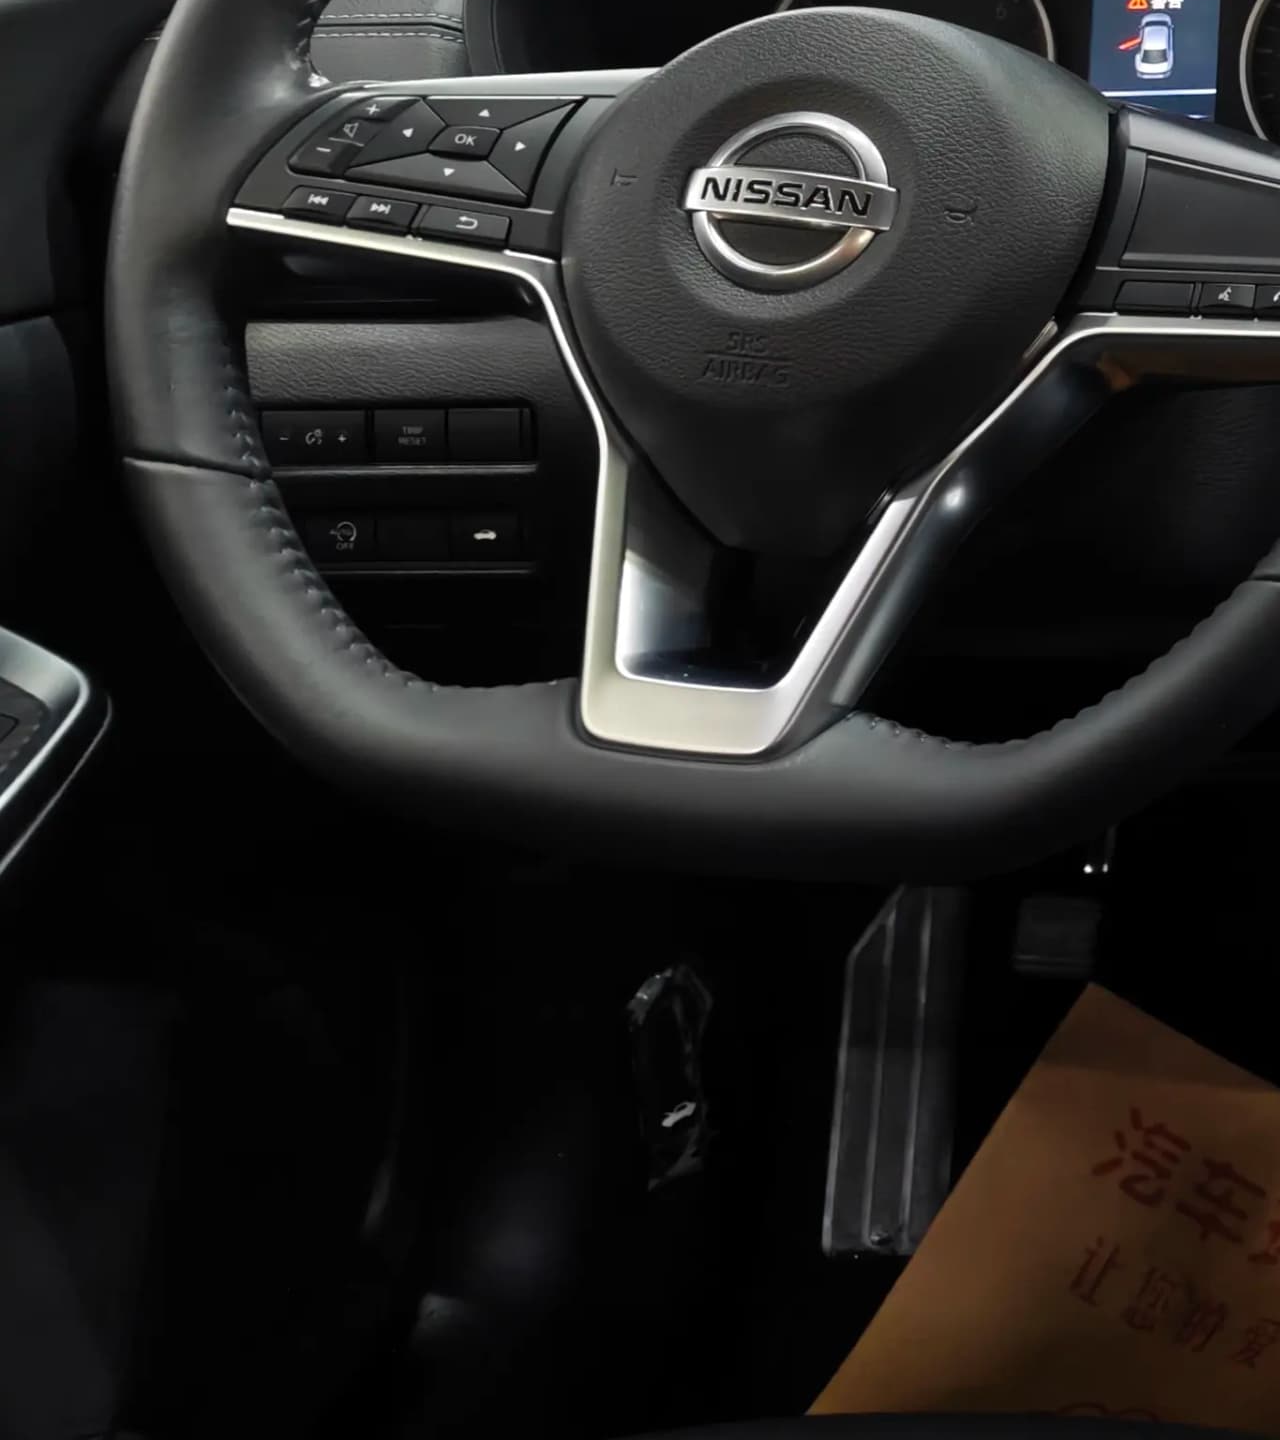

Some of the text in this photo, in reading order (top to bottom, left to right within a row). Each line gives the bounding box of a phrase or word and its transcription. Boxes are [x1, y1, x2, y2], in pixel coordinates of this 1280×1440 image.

[454, 132, 477, 148] OK
[700, 175, 873, 218] NISSAN
[727, 331, 769, 356] SRS
